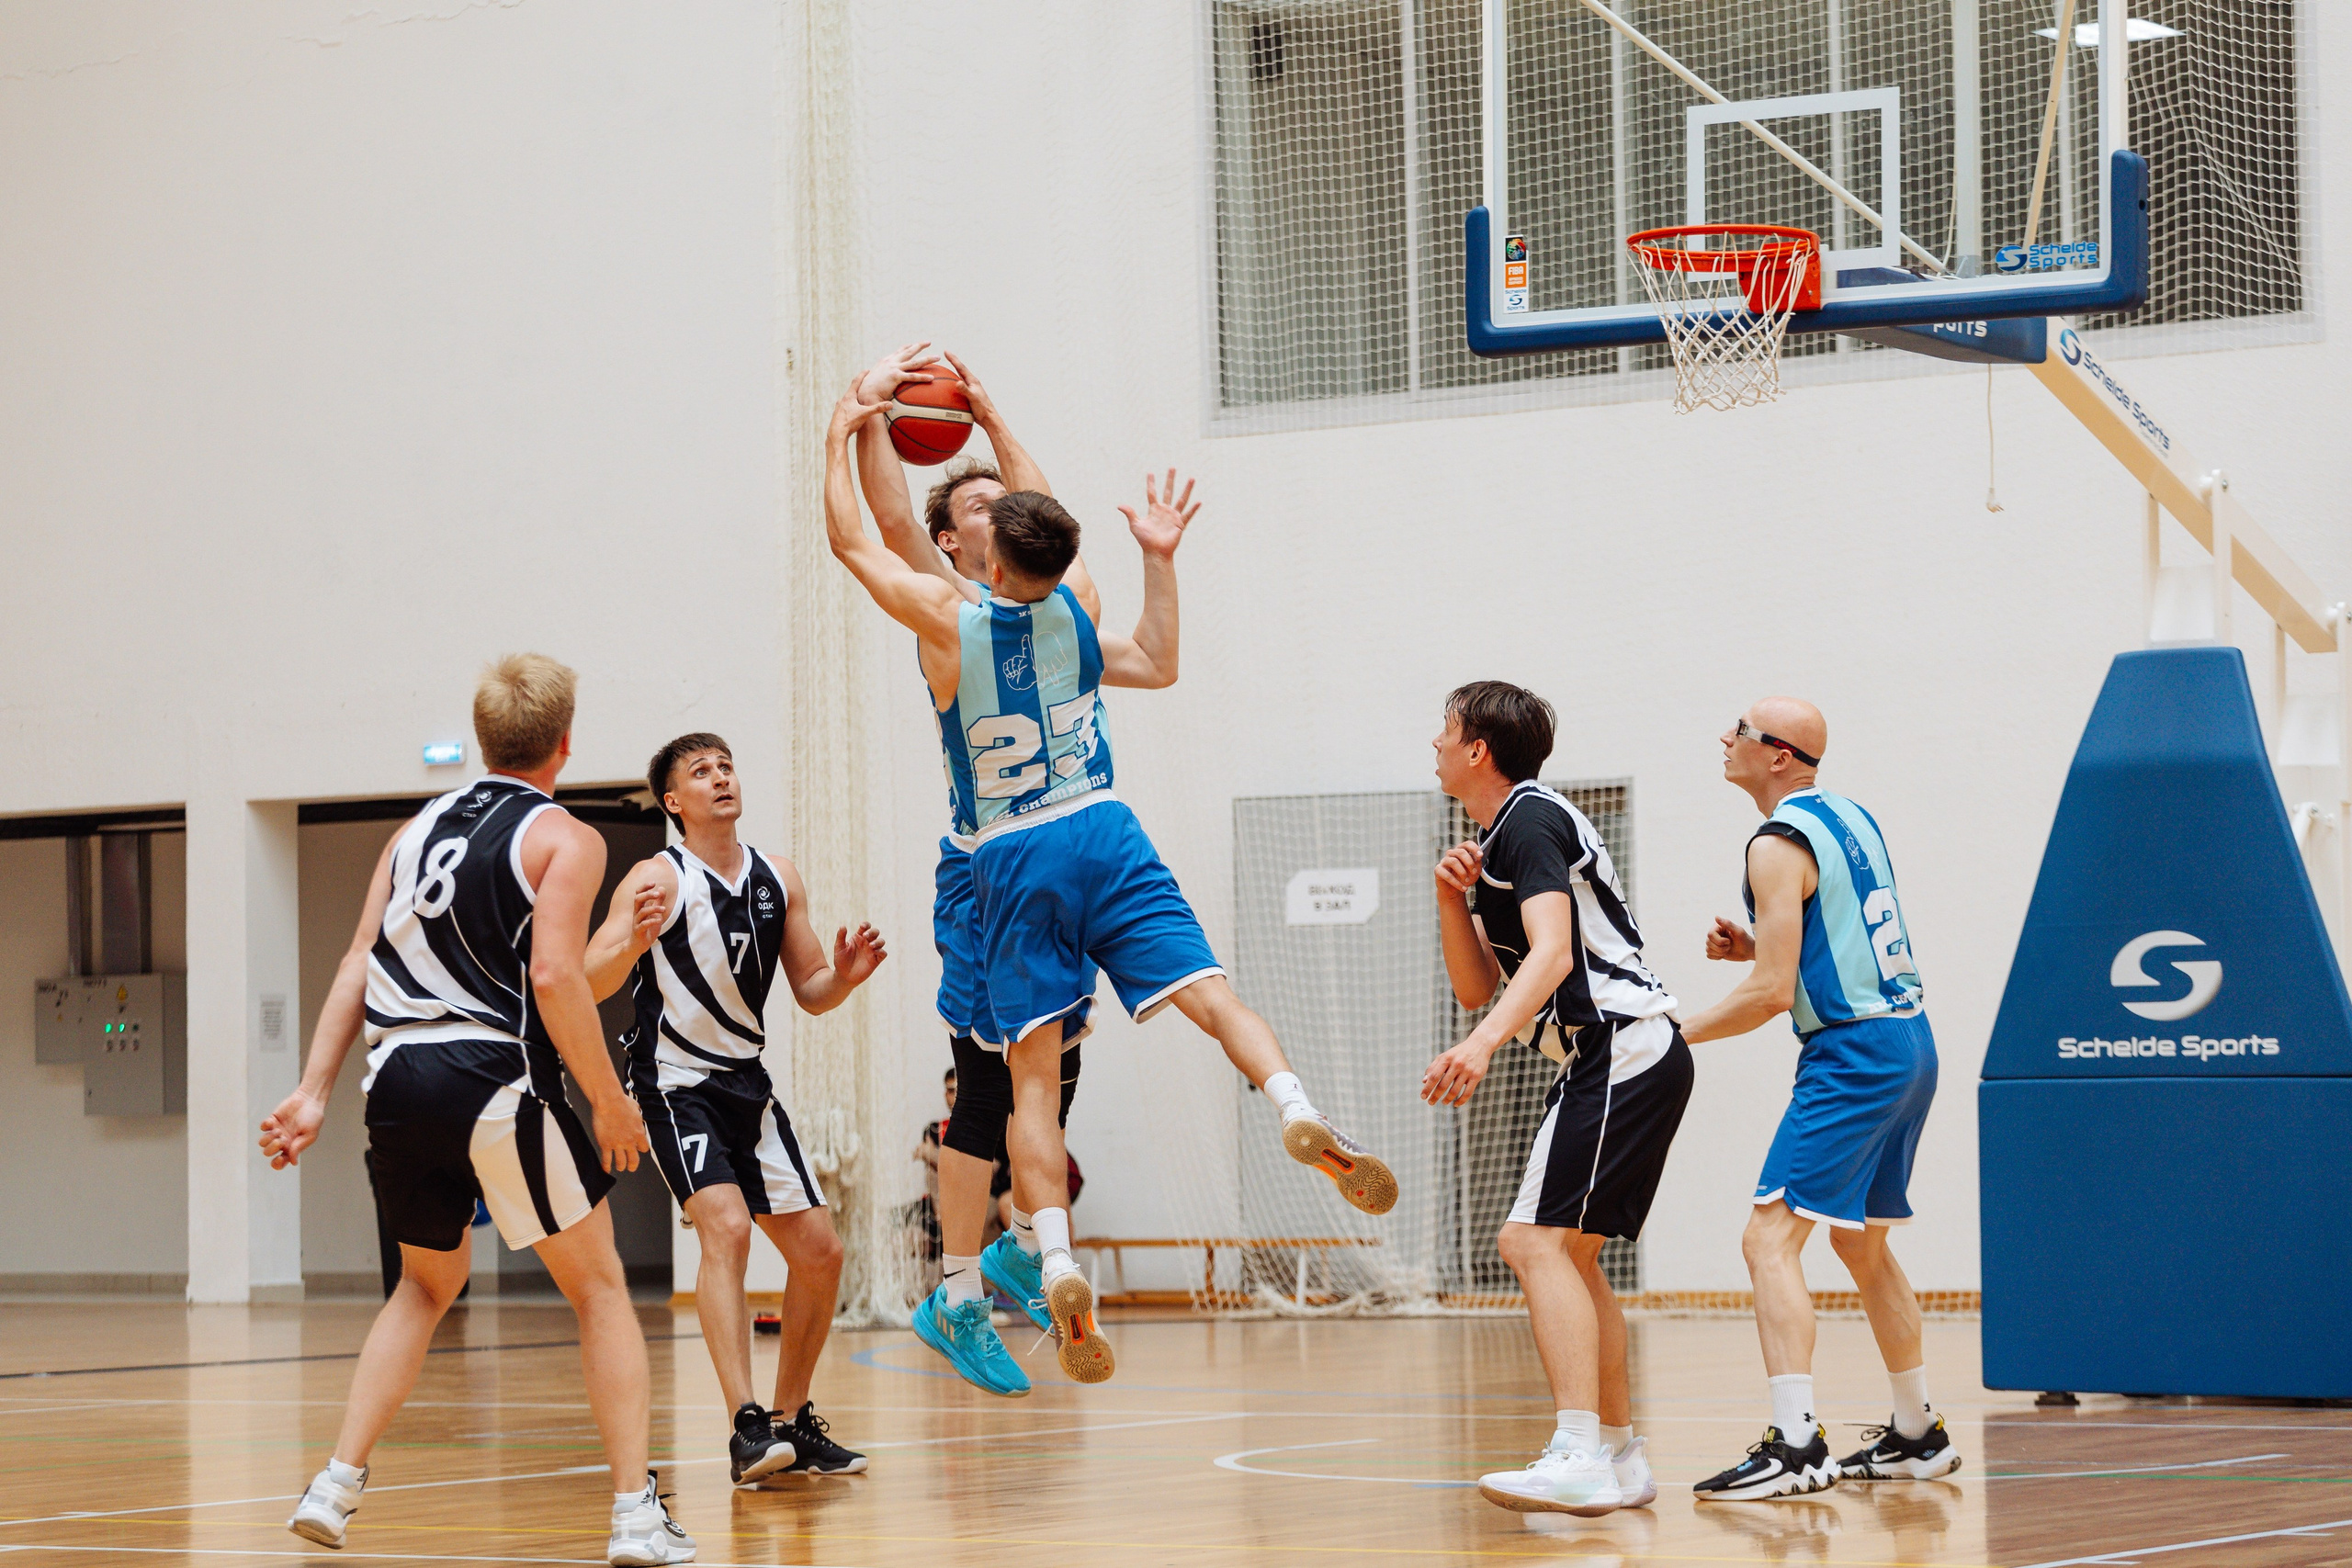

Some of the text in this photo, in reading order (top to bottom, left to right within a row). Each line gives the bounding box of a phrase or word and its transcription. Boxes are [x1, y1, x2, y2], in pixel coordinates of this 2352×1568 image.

[2029, 242, 2098, 255] Schelde
[2029, 253, 2098, 270] Sports
[1508, 265, 1524, 276] FIBA
[2083, 351, 2131, 411] Schelde
[2132, 400, 2170, 450] Sports
[967, 689, 1098, 799] 23
[413, 836, 469, 919] 8
[758, 901, 775, 910] ОДК
[729, 931, 751, 975] 7
[1862, 887, 1916, 981] 2
[2057, 1033, 2280, 1062] Schelde Sports
[681, 1133, 708, 1174] 7
